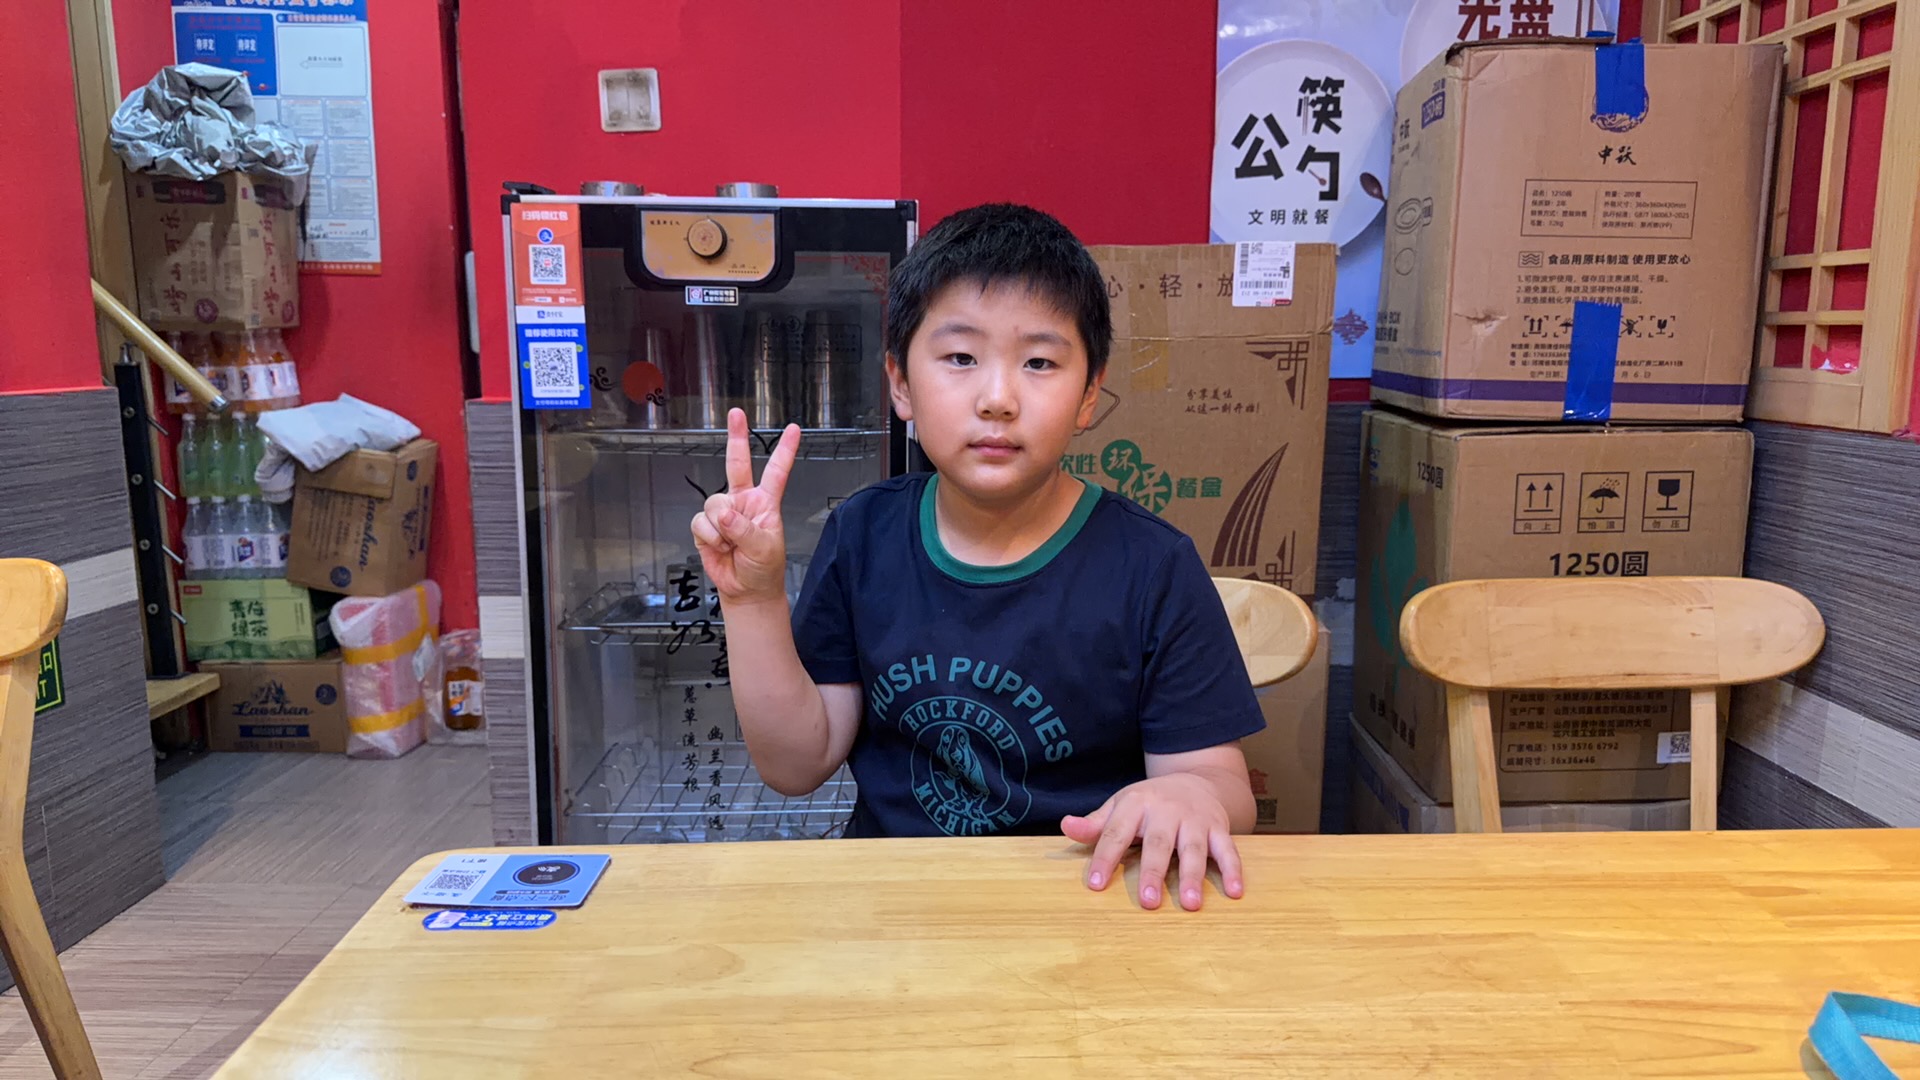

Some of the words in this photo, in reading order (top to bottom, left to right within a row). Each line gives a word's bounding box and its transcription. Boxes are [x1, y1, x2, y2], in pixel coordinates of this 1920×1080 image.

[1598, 145, 1637, 165] 中跃
[1248, 209, 1330, 225] 文明就餐
[1548, 254, 1630, 265] 食品用原料制造
[1632, 254, 1692, 265] 使用更放心
[1176, 476, 1223, 498] 餐盒
[359, 497, 381, 572] aoshan
[1550, 551, 1649, 577] 1250圆
[232, 701, 315, 716] Laoshan
[871, 654, 937, 721] HUSH
[948, 656, 1074, 763] PUPPIES
[904, 699, 1016, 751] ROCKFORD
[915, 780, 1017, 836] MICHIGAN
